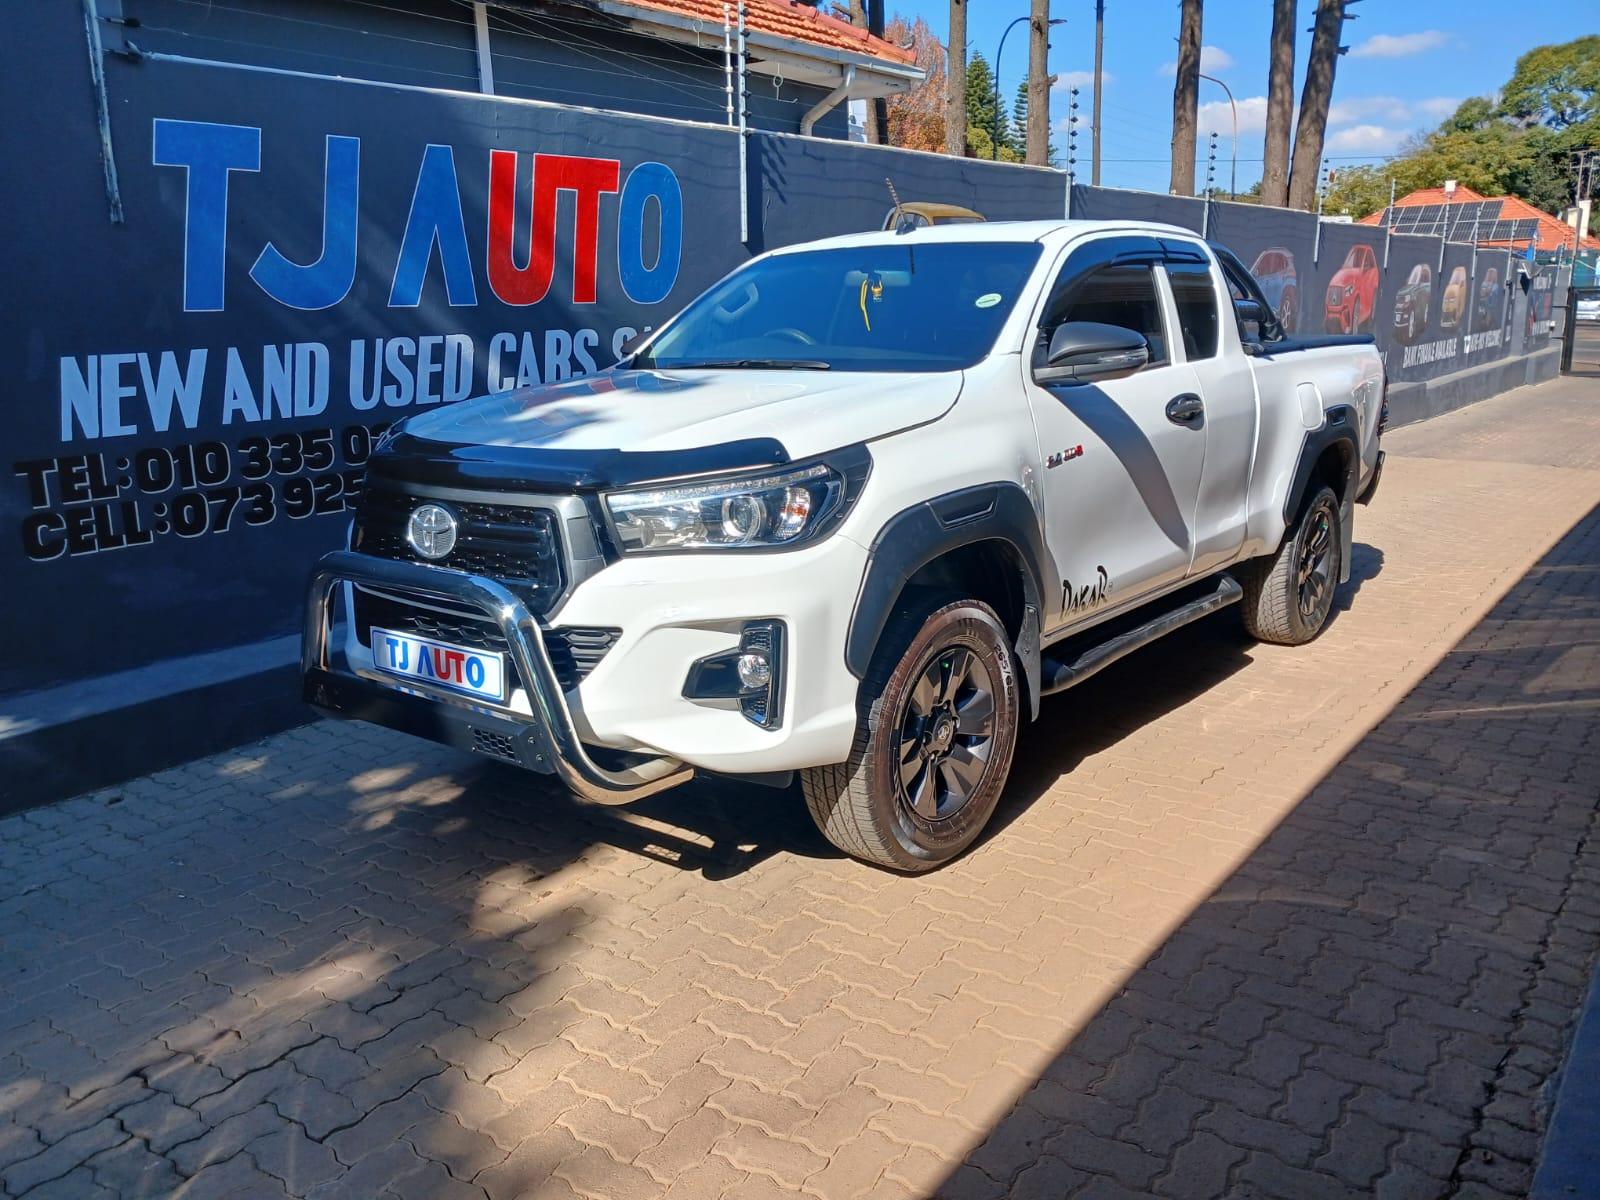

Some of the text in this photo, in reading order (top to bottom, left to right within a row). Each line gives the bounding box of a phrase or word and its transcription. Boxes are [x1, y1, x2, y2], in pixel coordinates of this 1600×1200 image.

[152, 118, 683, 312] TJ AUTO
[60, 349, 208, 441] NEW
[222, 342, 329, 425] AND
[349, 334, 474, 410] USED
[487, 328, 599, 394] CARS
[14, 441, 232, 510] TEL:010
[238, 427, 336, 481] 335
[22, 471, 368, 562] CELL:073 925
[386, 637, 485, 689] TJ AUTO
